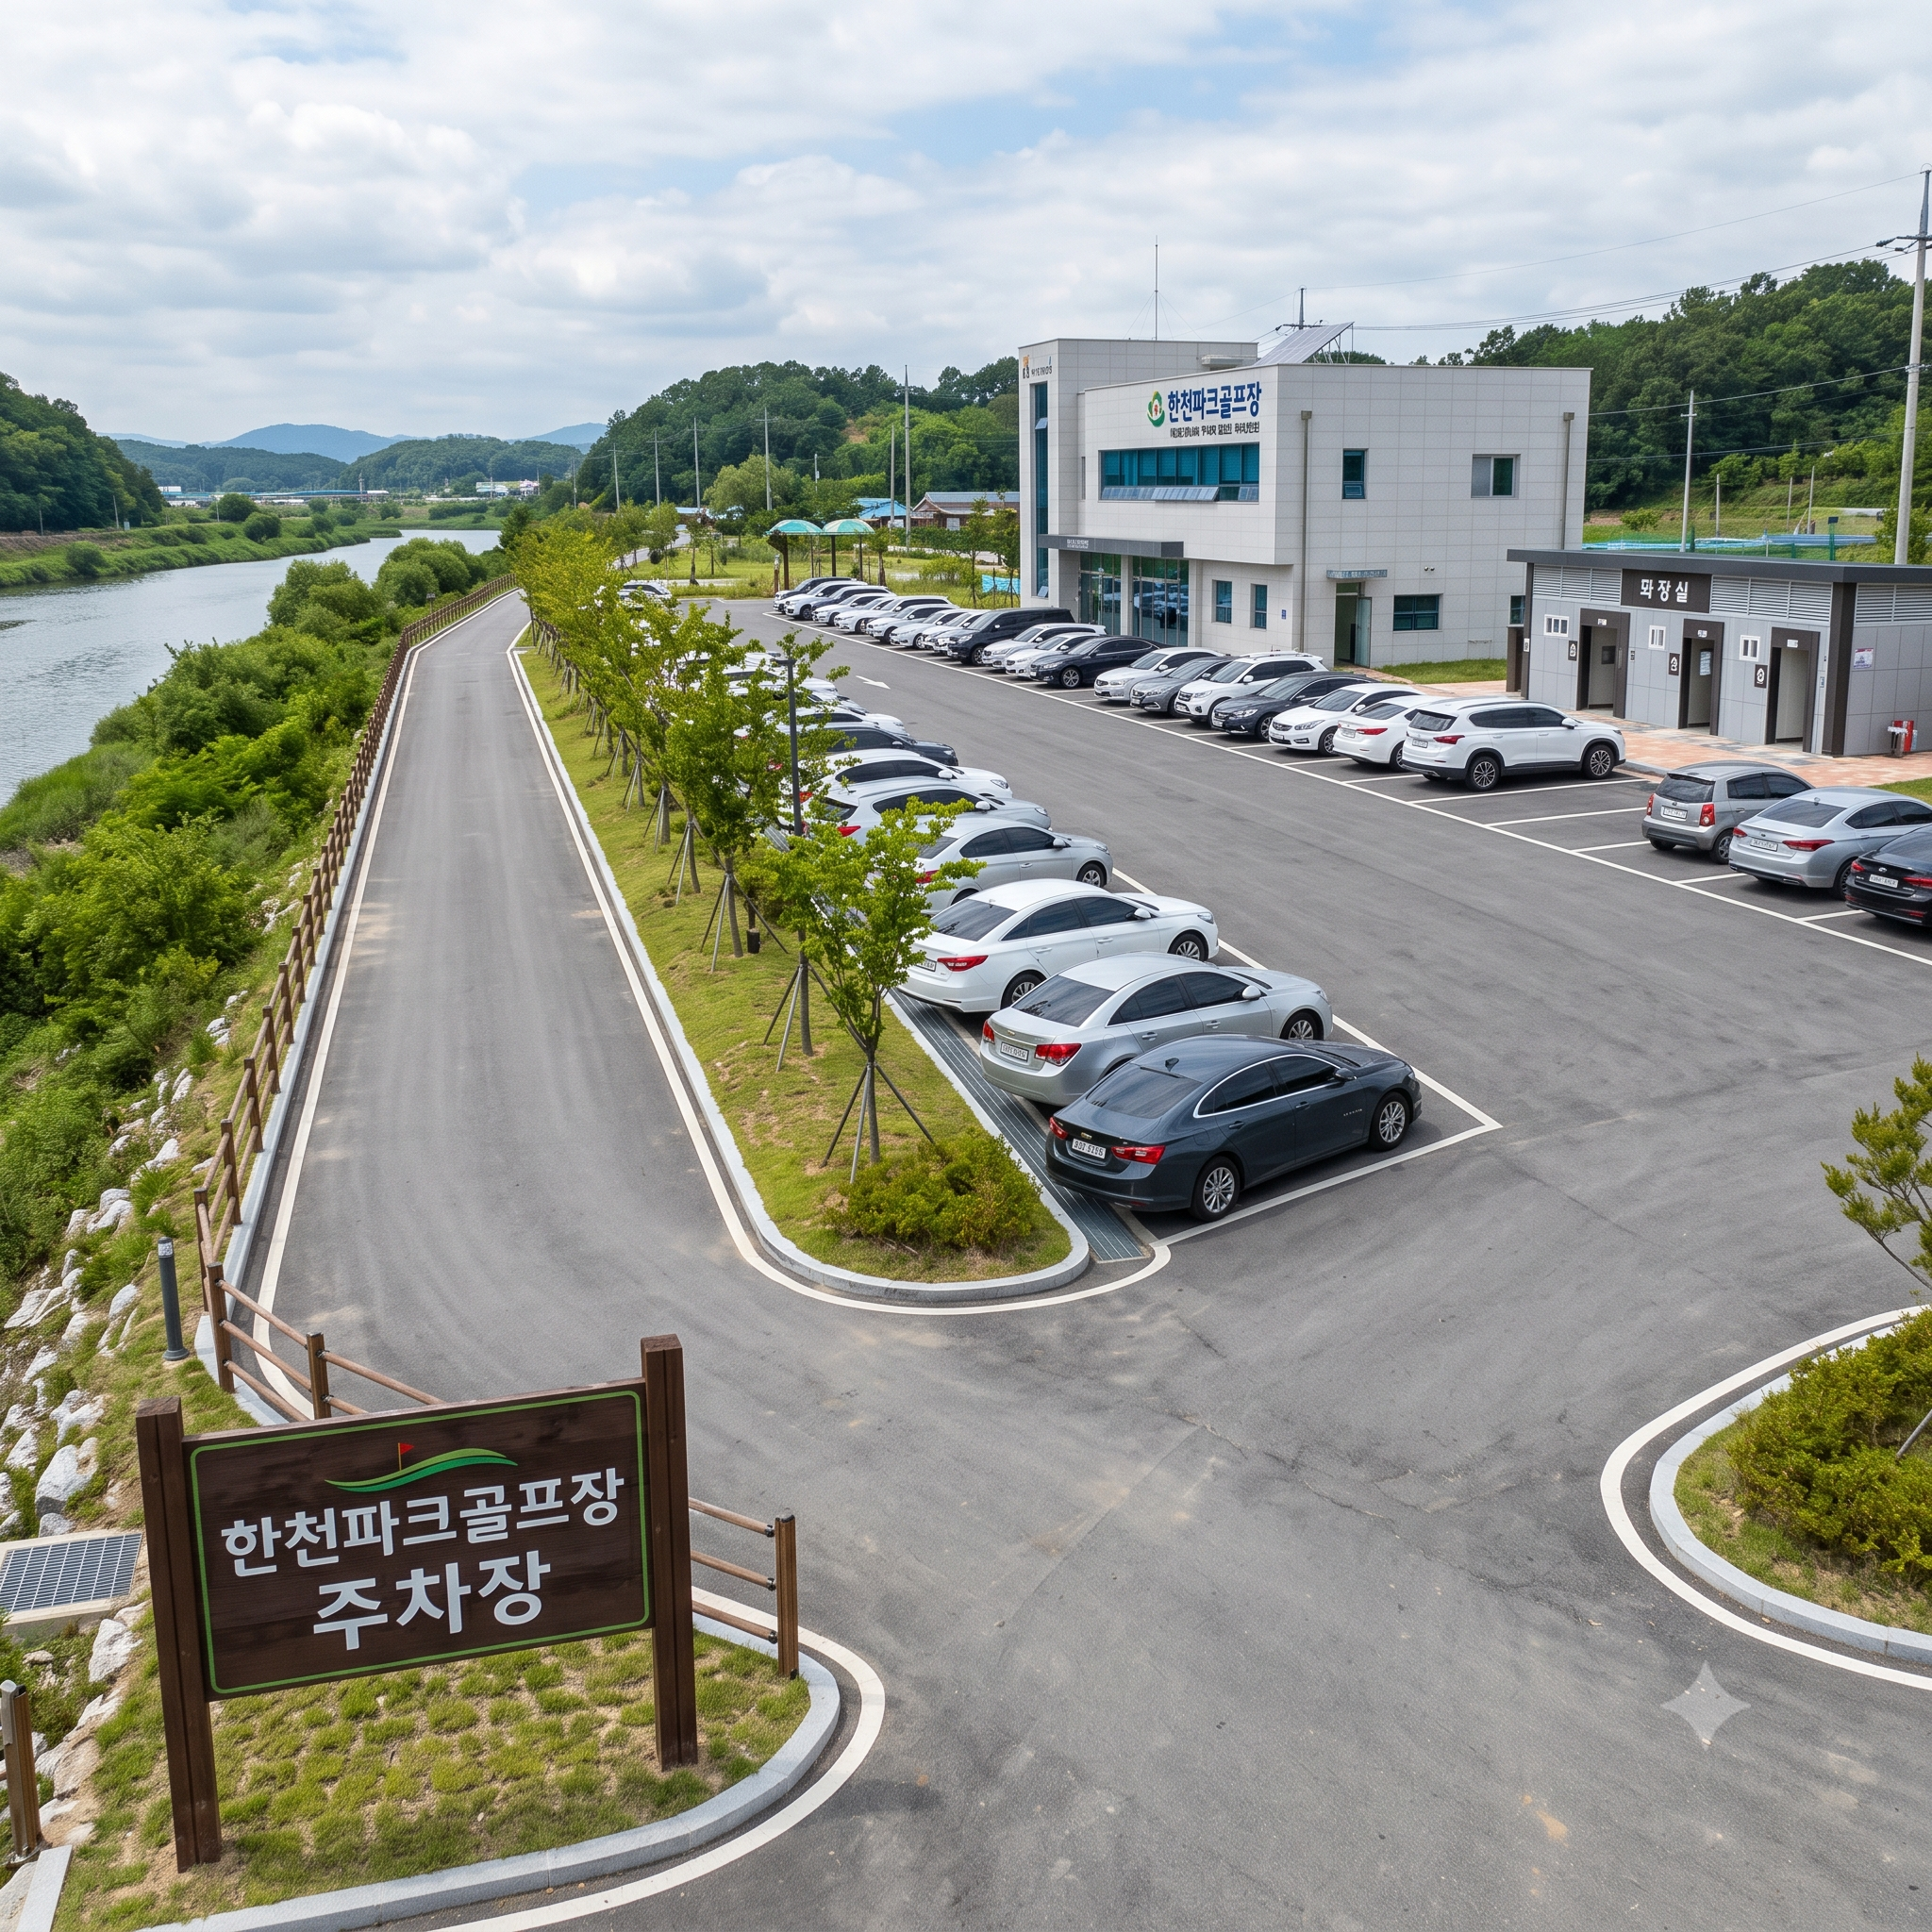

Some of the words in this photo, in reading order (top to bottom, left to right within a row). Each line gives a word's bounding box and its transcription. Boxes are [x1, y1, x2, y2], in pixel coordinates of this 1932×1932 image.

[1168, 381, 1261, 423] 한천파크골프장
[221, 1468, 625, 1577] 한천파크골프장
[313, 1550, 551, 1651] 주차장
